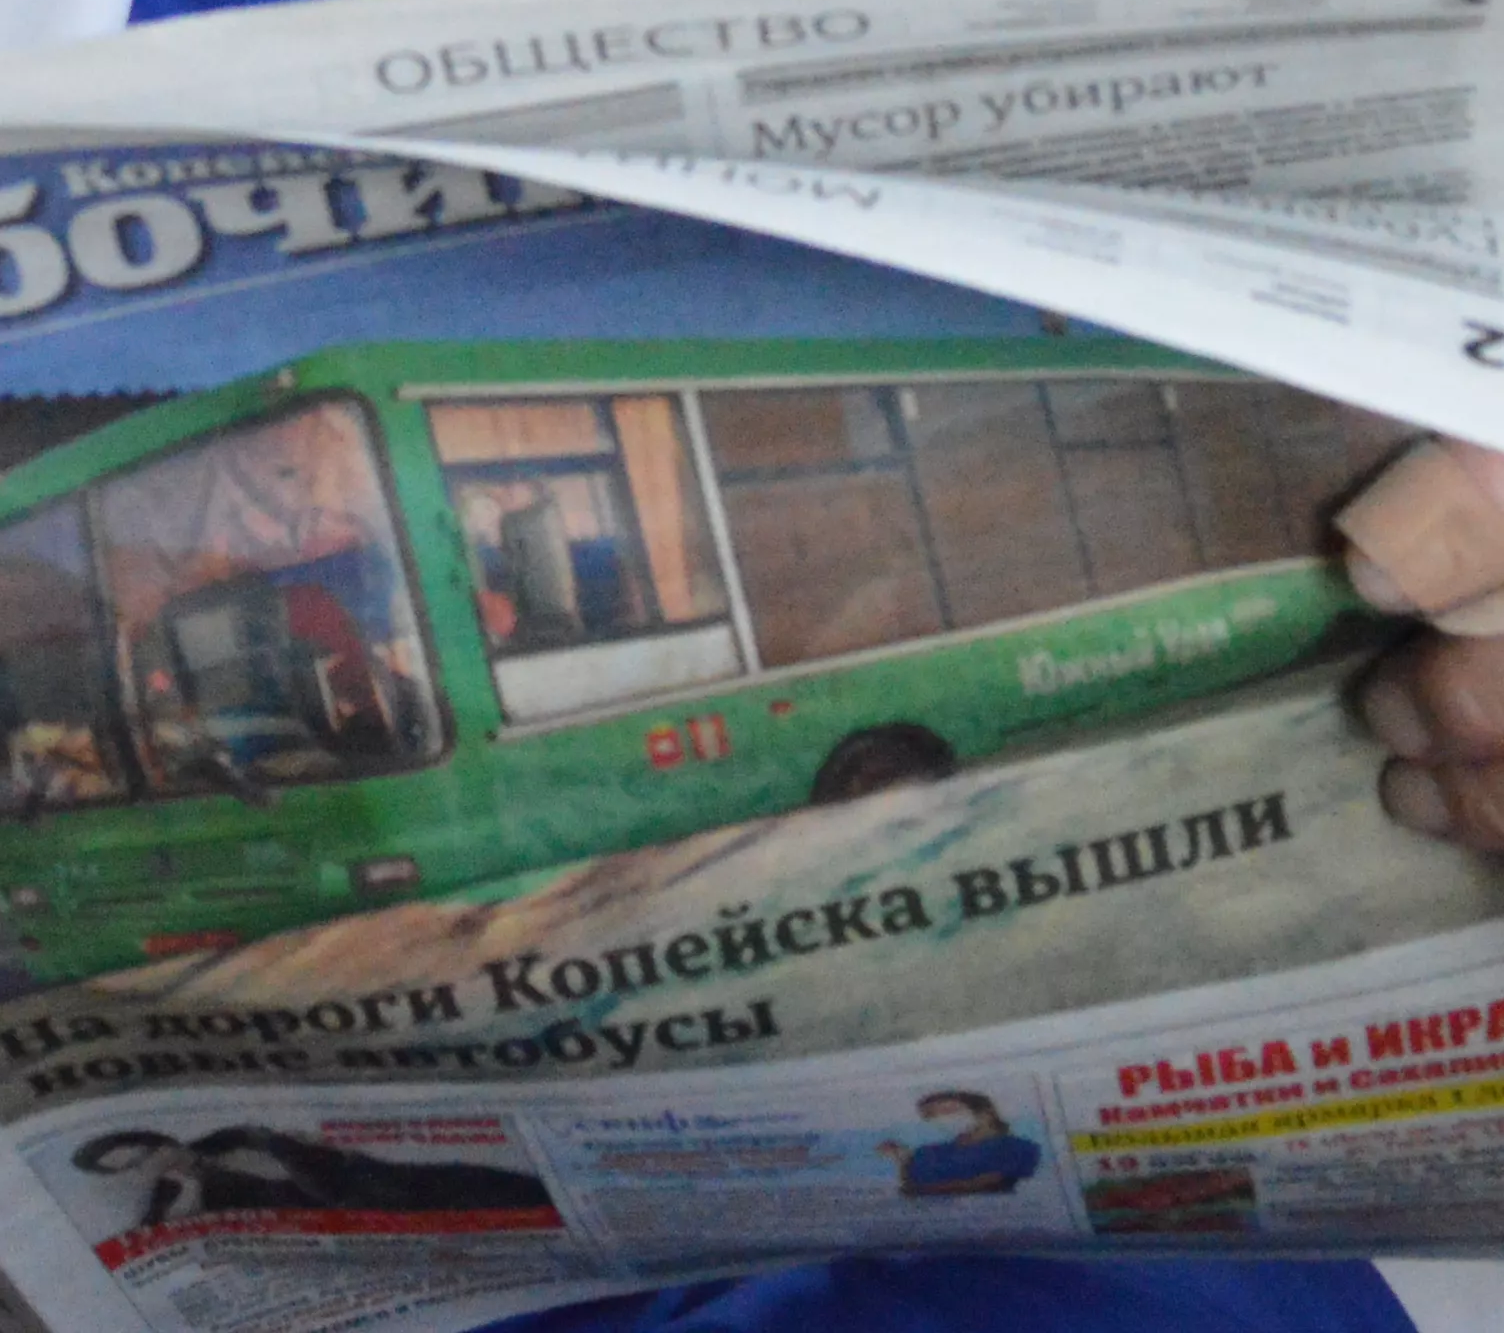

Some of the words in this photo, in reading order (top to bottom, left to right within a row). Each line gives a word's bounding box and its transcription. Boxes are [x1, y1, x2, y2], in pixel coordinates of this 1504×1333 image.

[375, 7, 872, 95] ОБЩЕСТВО
[749, 97, 964, 161] Мусор
[982, 64, 1282, 137] убирают
[144, 968, 466, 1061] дороги
[480, 855, 936, 1017] Копейска
[950, 789, 1297, 925] вышли
[343, 983, 782, 1089] автобусы
[1117, 1038, 1298, 1099] РЫБА
[1311, 1035, 1352, 1070] и
[1098, 1081, 1305, 1127] Камчатки
[1313, 1075, 1342, 1096] и
